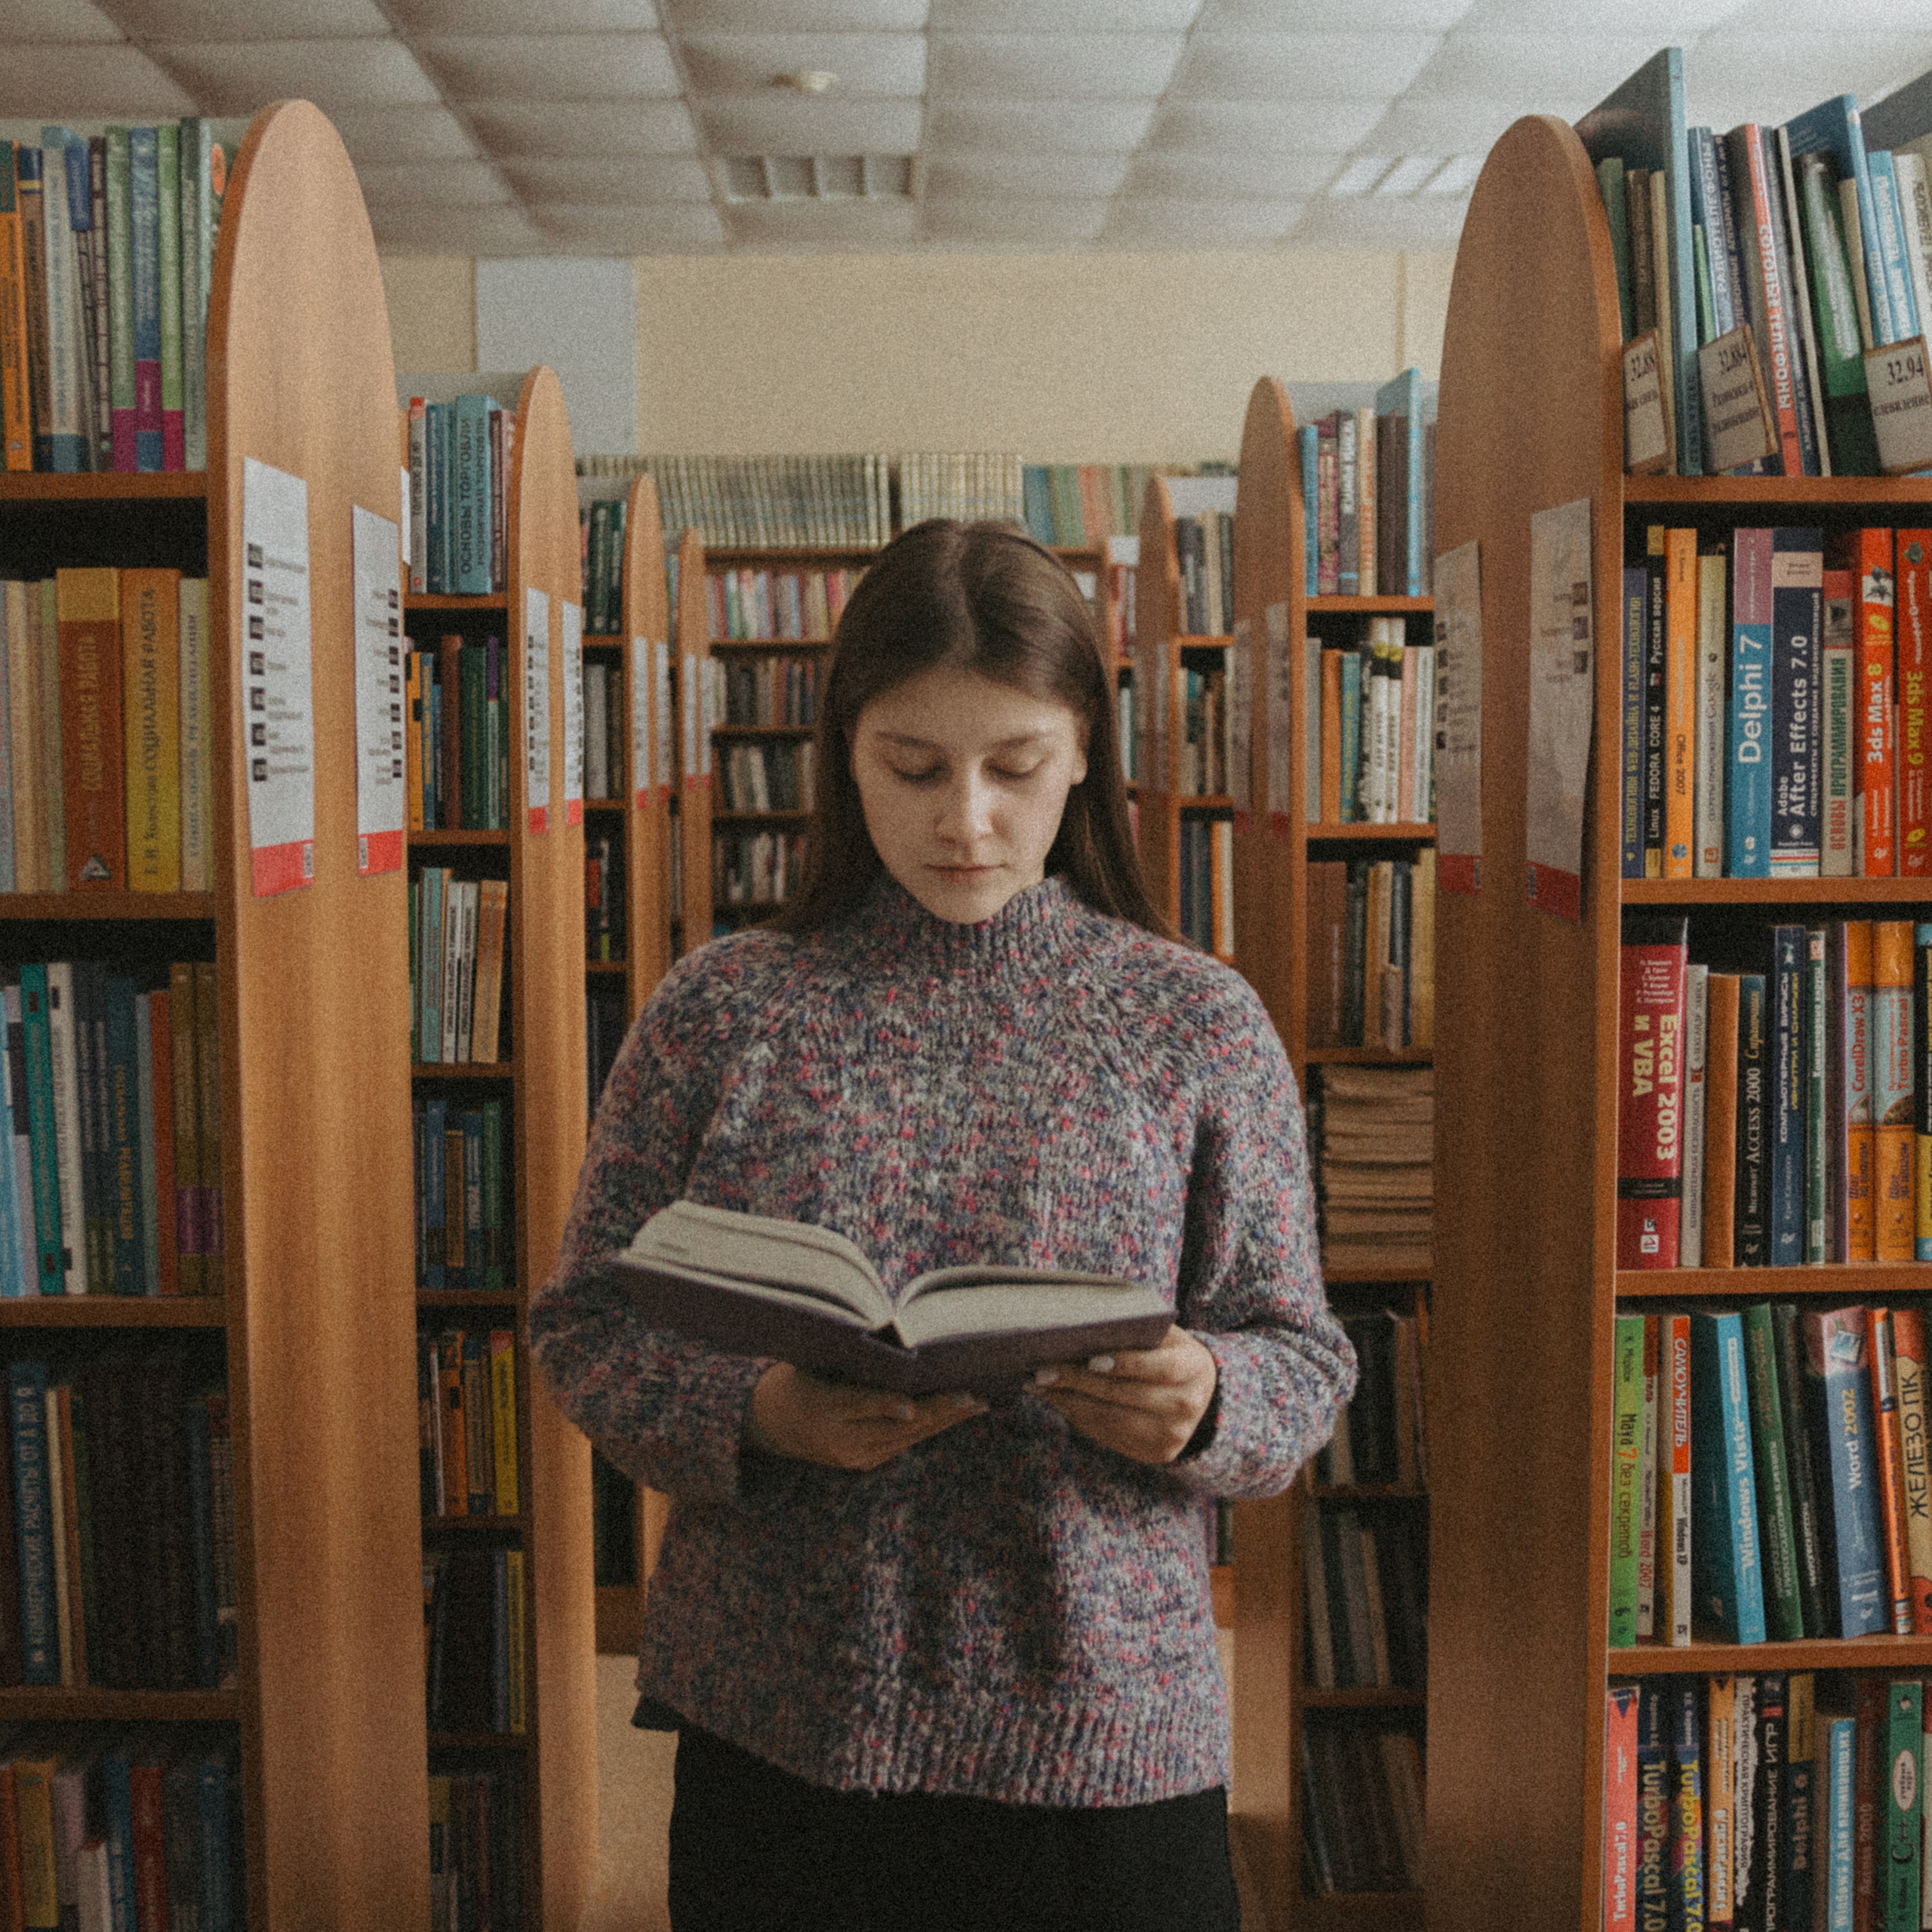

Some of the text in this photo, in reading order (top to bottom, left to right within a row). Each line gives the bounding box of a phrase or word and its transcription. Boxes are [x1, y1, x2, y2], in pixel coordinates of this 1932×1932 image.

[1703, 143, 1727, 294] РАДИОТЕЛЕФОНЫ
[1722, 191, 1735, 250] АППАРАТЫ
[1730, 255, 1744, 323] ЛЕФОННЫЕ
[1760, 225, 1790, 409] СОТОВЫЕ ТЕЛЕФОНЫ
[1887, 355, 1924, 386] 32.94
[460, 418, 472, 574] ОСНОВЫ ТОРГОВЛИ
[142, 590, 155, 653] РАБОТА
[1651, 576, 1662, 617] версия
[1651, 620, 1662, 665] Русская
[143, 659, 160, 771] СОЦИАЛЬНАЯ
[1706, 672, 1719, 718] Google
[1737, 635, 1767, 764] Delphi 7
[1867, 663, 1884, 763] 3ds Max 8
[1906, 671, 1924, 705] 3ds
[1649, 715, 1660, 747] CORE
[1675, 734, 1686, 765] Office
[1790, 635, 1807, 817] After Effects 7.0
[1830, 658, 1847, 850] ОСНОВЫ ПРОГРАММИРОВАНИЯ
[1907, 708, 1924, 749] Max
[1909, 752, 1924, 765] 9
[1649, 752, 1660, 799] FEDORA
[1675, 768, 1686, 795] 2007
[1777, 777, 1789, 816] Adobe
[1626, 776, 1638, 844] ТЕХНОЛОГИИ
[1649, 808, 1660, 838] Linux
[1632, 1015, 1654, 1097] и VBA
[1780, 972, 1789, 1143] КОМПЬЮТЕРНЫЕ ВИРУСЫ
[1851, 995, 1866, 1092] CorelDraw X3
[1897, 998, 1909, 1091] Turbo Pascal
[1657, 1014, 1678, 1160] Excel 2003
[1747, 1067, 1761, 1103] 2000
[1746, 1106, 1761, 1164] ACCESS
[1674, 1337, 1687, 1448] САМОУЧИТЕЛЬ
[1732, 1420, 1749, 1474] Vista
[1841, 1388, 1863, 1490] Word 2002
[1900, 1371, 1929, 1518] ЖЕЛЕЗО ПК
[16, 1387, 46, 1645] КОММЕРЧЕСКИЕ РАСЧЕТЫ ОТ А ДО Я
[1617, 1413, 1638, 1558] Maya 7 без секретов
[1675, 1518, 1687, 1552] Windows
[1735, 1475, 1756, 1571] Windows
[1638, 1562, 1652, 1589] 2007
[1677, 1555, 1687, 1565] XP
[1765, 1722, 1777, 1763] ИГР
[1740, 1694, 1749, 1869] ПРАКТИЧЕСКАЯ КРИПТОГРАФИЯ
[1644, 1761, 1666, 1931] TurboPascal 7.0
[1681, 1760, 1703, 1932] TurboPascal 7.0
[1792, 1795, 1810, 1870] Delphi
[1860, 1803, 1874, 1841] 2000
[1891, 1820, 1915, 1864] C++
[1834, 1866, 1848, 1928] Windows
